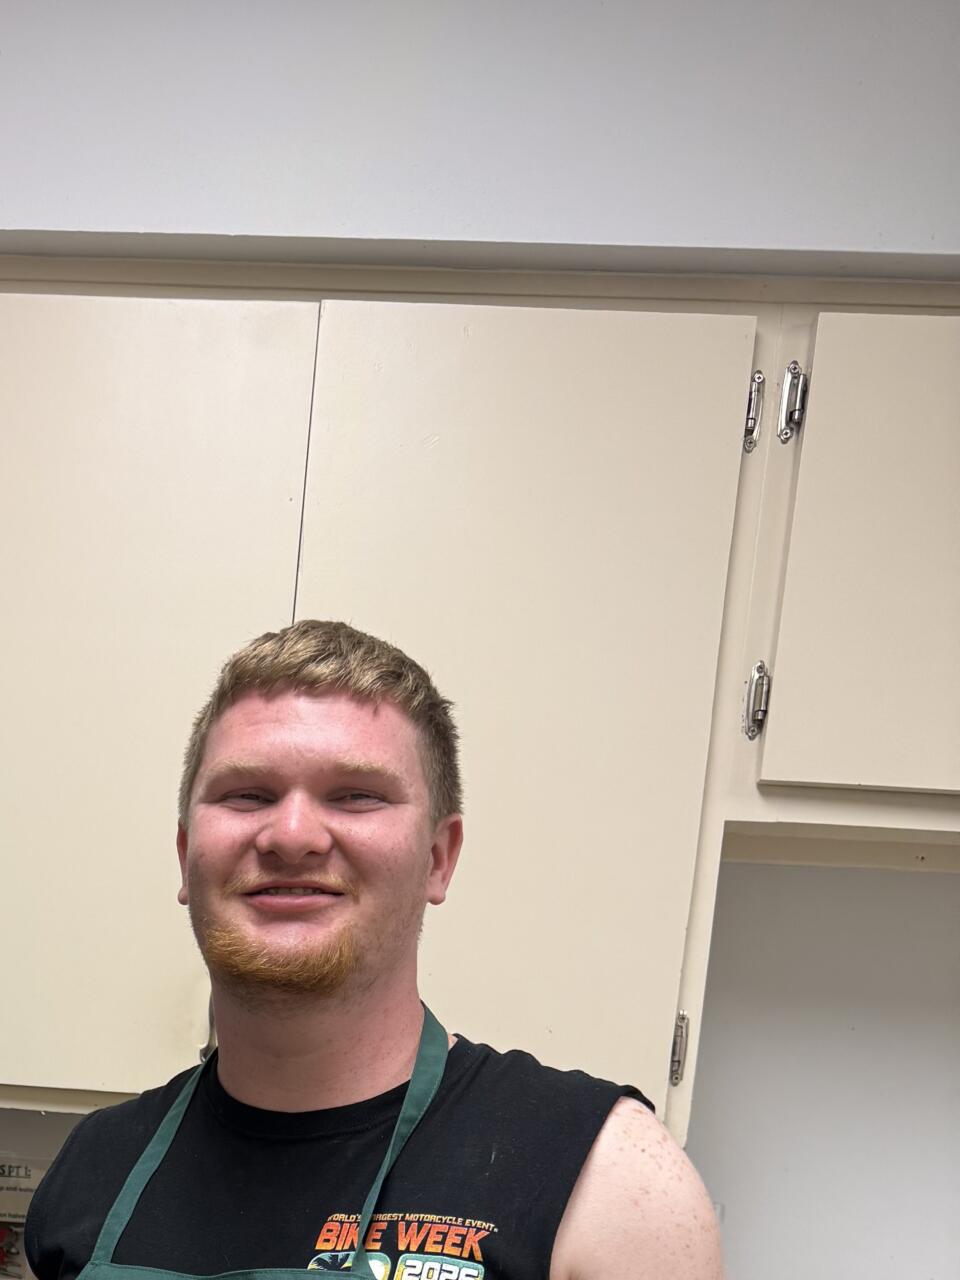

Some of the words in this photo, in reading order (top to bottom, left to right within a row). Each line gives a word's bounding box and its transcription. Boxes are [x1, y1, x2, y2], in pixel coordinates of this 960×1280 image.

[404, 1213, 463, 1225] MOTORCYCLE
[314, 1221, 388, 1251] BIKE
[396, 1221, 490, 1262] WEEK
